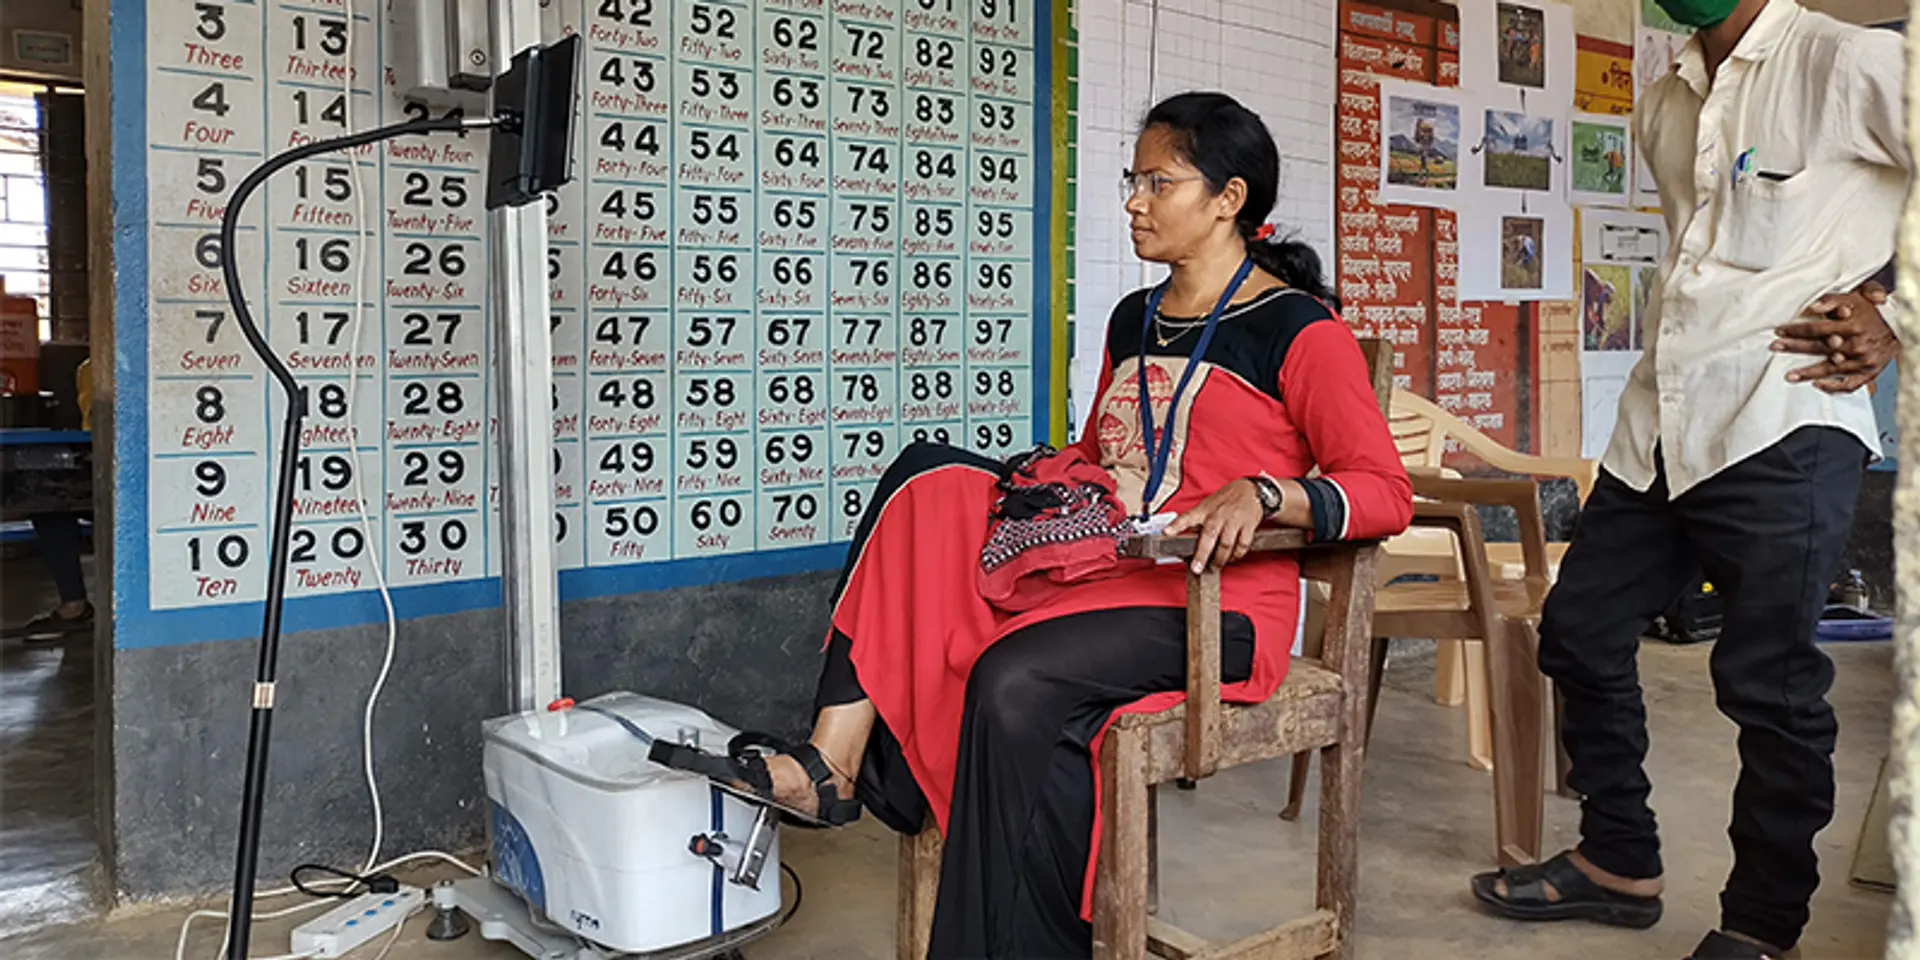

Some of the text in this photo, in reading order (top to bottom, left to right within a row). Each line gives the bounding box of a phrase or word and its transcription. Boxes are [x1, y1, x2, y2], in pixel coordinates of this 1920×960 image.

[195, 2, 225, 40] 3
[690, 4, 735, 40] 52
[773, 17, 817, 51] 62
[292, 16, 347, 57] 13
[847, 27, 884, 60] 72
[184, 44, 244, 70] Three
[916, 37, 954, 70] 82
[979, 47, 1017, 78] 92
[599, 57, 655, 93] 43
[691, 68, 739, 100] 53
[192, 82, 230, 117] 4
[773, 77, 819, 109] 63
[847, 86, 889, 118] 73
[293, 90, 347, 128] 14
[916, 94, 954, 125] 83
[980, 102, 1015, 131] 93
[183, 122, 235, 145] Four
[600, 122, 660, 156] 44
[690, 130, 740, 162] 54
[775, 138, 820, 168] 64
[849, 144, 889, 174] 74
[916, 150, 957, 179] 84
[197, 158, 226, 194] 5
[295, 165, 351, 202] 15
[980, 155, 1018, 184] 94
[403, 172, 467, 208] 25
[601, 189, 655, 221] 45
[187, 199, 226, 220] Five
[292, 206, 354, 226] Fifteen
[692, 194, 738, 225] 55
[774, 199, 816, 229] 65
[850, 203, 889, 233] 75
[915, 207, 953, 237] 85
[978, 210, 1013, 238] 95
[195, 232, 222, 270] 6
[296, 237, 350, 273] 16
[403, 242, 466, 277] 26
[602, 251, 657, 281] 46
[188, 274, 220, 293] Six
[692, 254, 737, 284] 56
[773, 256, 812, 285] 66
[849, 260, 889, 287] 76
[913, 261, 952, 289] 86
[978, 263, 1012, 289] 96
[287, 278, 351, 296] Sixteen
[195, 310, 225, 343] 7
[296, 311, 349, 345] 17
[403, 313, 462, 345] 27
[595, 316, 650, 345] 47
[687, 317, 736, 347] 57
[768, 318, 811, 346] 67
[842, 318, 882, 345] 77
[909, 317, 947, 347] 87
[975, 319, 1012, 345] 97
[181, 352, 240, 370] Seven
[287, 351, 375, 369] Seventen
[403, 381, 464, 416] 28
[598, 378, 654, 410] 48
[686, 378, 735, 407] 58
[768, 375, 814, 405] 68
[842, 374, 878, 402] 78
[911, 371, 952, 401] 88
[975, 370, 1014, 397] 98
[196, 386, 225, 424] 8
[299, 383, 348, 419] 18
[182, 426, 234, 449] Eight
[765, 434, 813, 465] 69
[843, 430, 884, 458] 79
[976, 423, 1013, 450] 99
[404, 449, 465, 486] 29
[599, 442, 654, 474] 49
[686, 437, 738, 470] 59
[195, 460, 226, 497] 9
[298, 455, 352, 490] 19
[191, 504, 236, 523] Nine
[605, 506, 658, 537] 50
[691, 499, 742, 531] 60
[772, 494, 817, 523] 70
[290, 527, 364, 563] 20
[399, 519, 467, 555] 30
[696, 533, 729, 549] Sixty
[769, 524, 816, 542] Seventy
[187, 535, 249, 571] 10
[610, 541, 644, 558] Fifty
[296, 566, 361, 588] Twenty
[405, 557, 463, 576] Thirty
[196, 577, 237, 598] Ten
